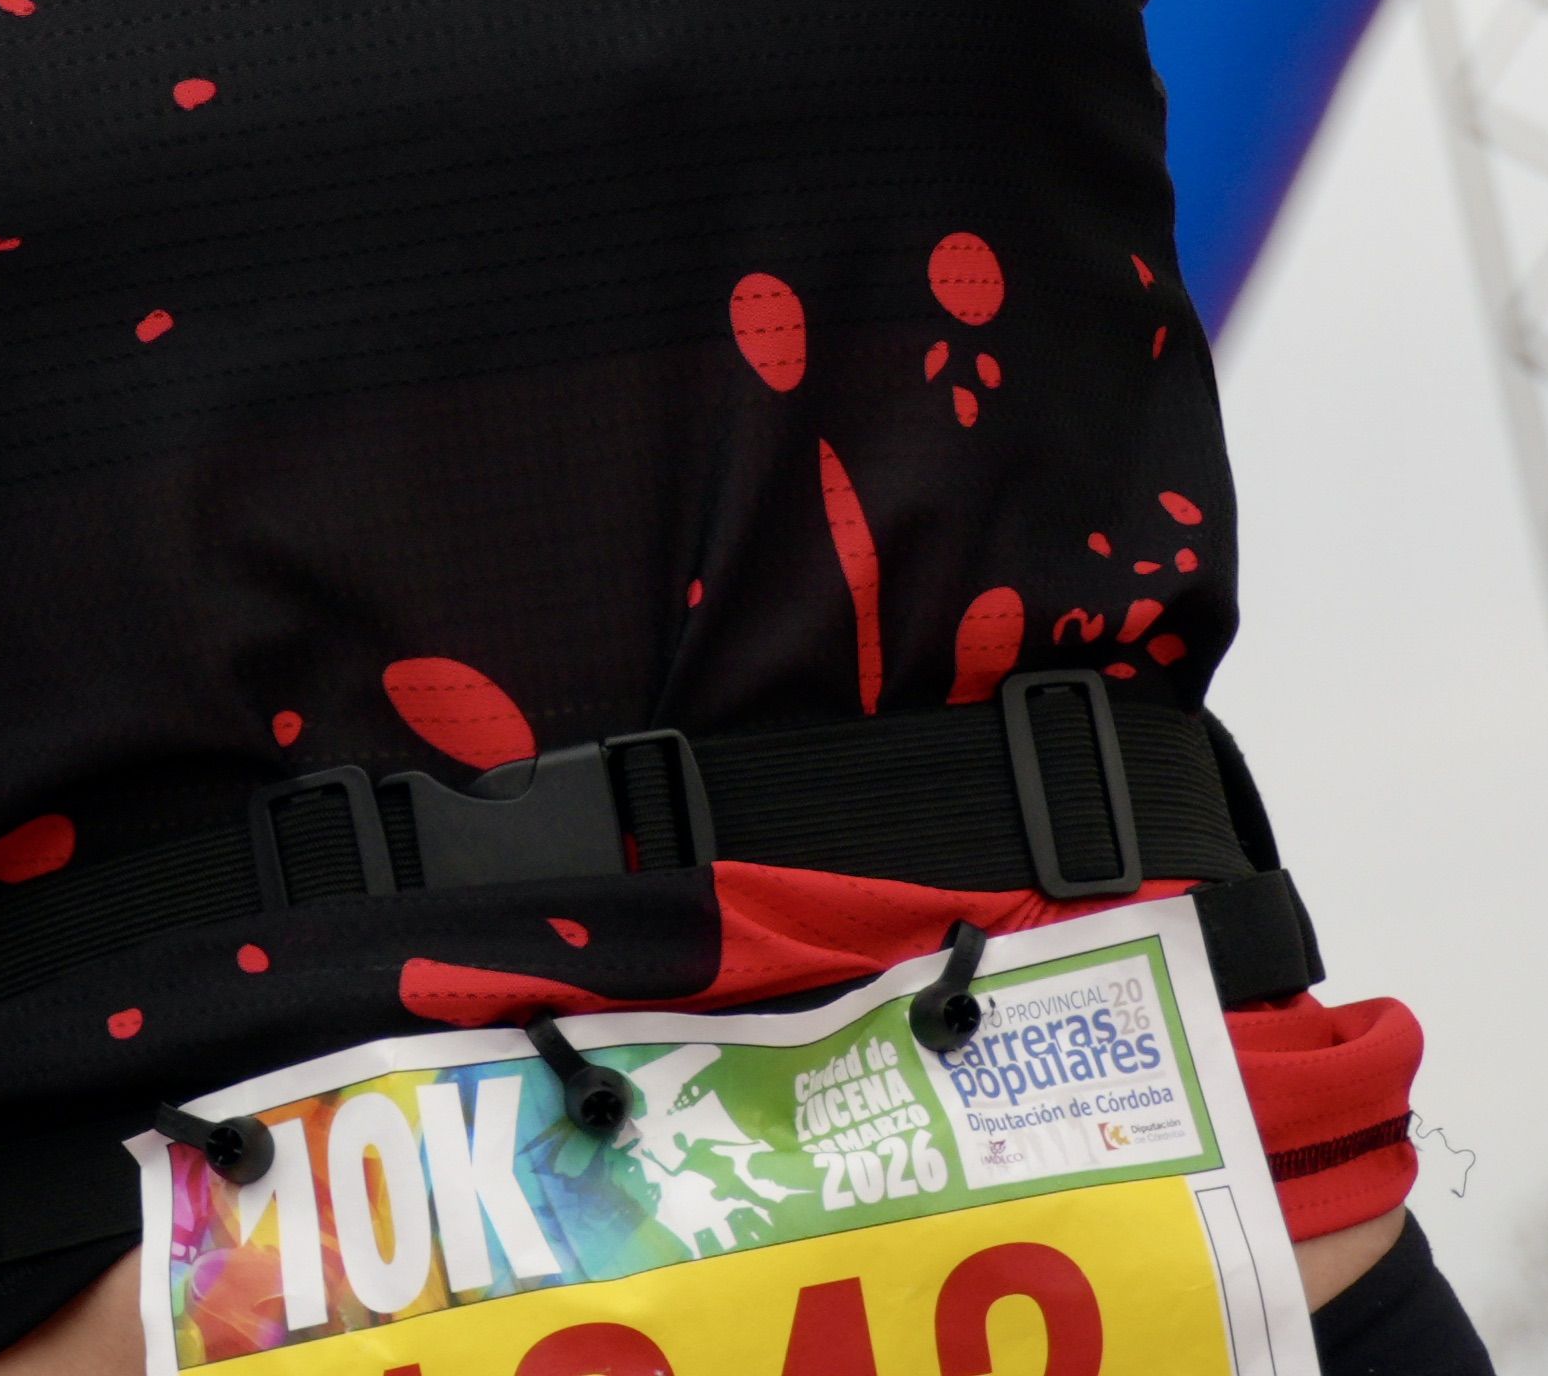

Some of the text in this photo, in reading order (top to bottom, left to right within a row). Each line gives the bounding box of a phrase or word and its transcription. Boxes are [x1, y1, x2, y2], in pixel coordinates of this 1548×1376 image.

[1007, 985, 1109, 1024] PROVINCIAL
[1108, 978, 1143, 1008] 20
[1116, 1006, 1150, 1035] 26
[795, 1037, 898, 1103] Ciudad de
[950, 1033, 1161, 1107] populares
[795, 1068, 915, 1142] LUCENA
[834, 1104, 930, 1152] MARZO
[967, 1087, 1174, 1135] Diputación de Córdoba
[239, 1075, 561, 1331] 10K
[814, 1129, 948, 1211] 2026
